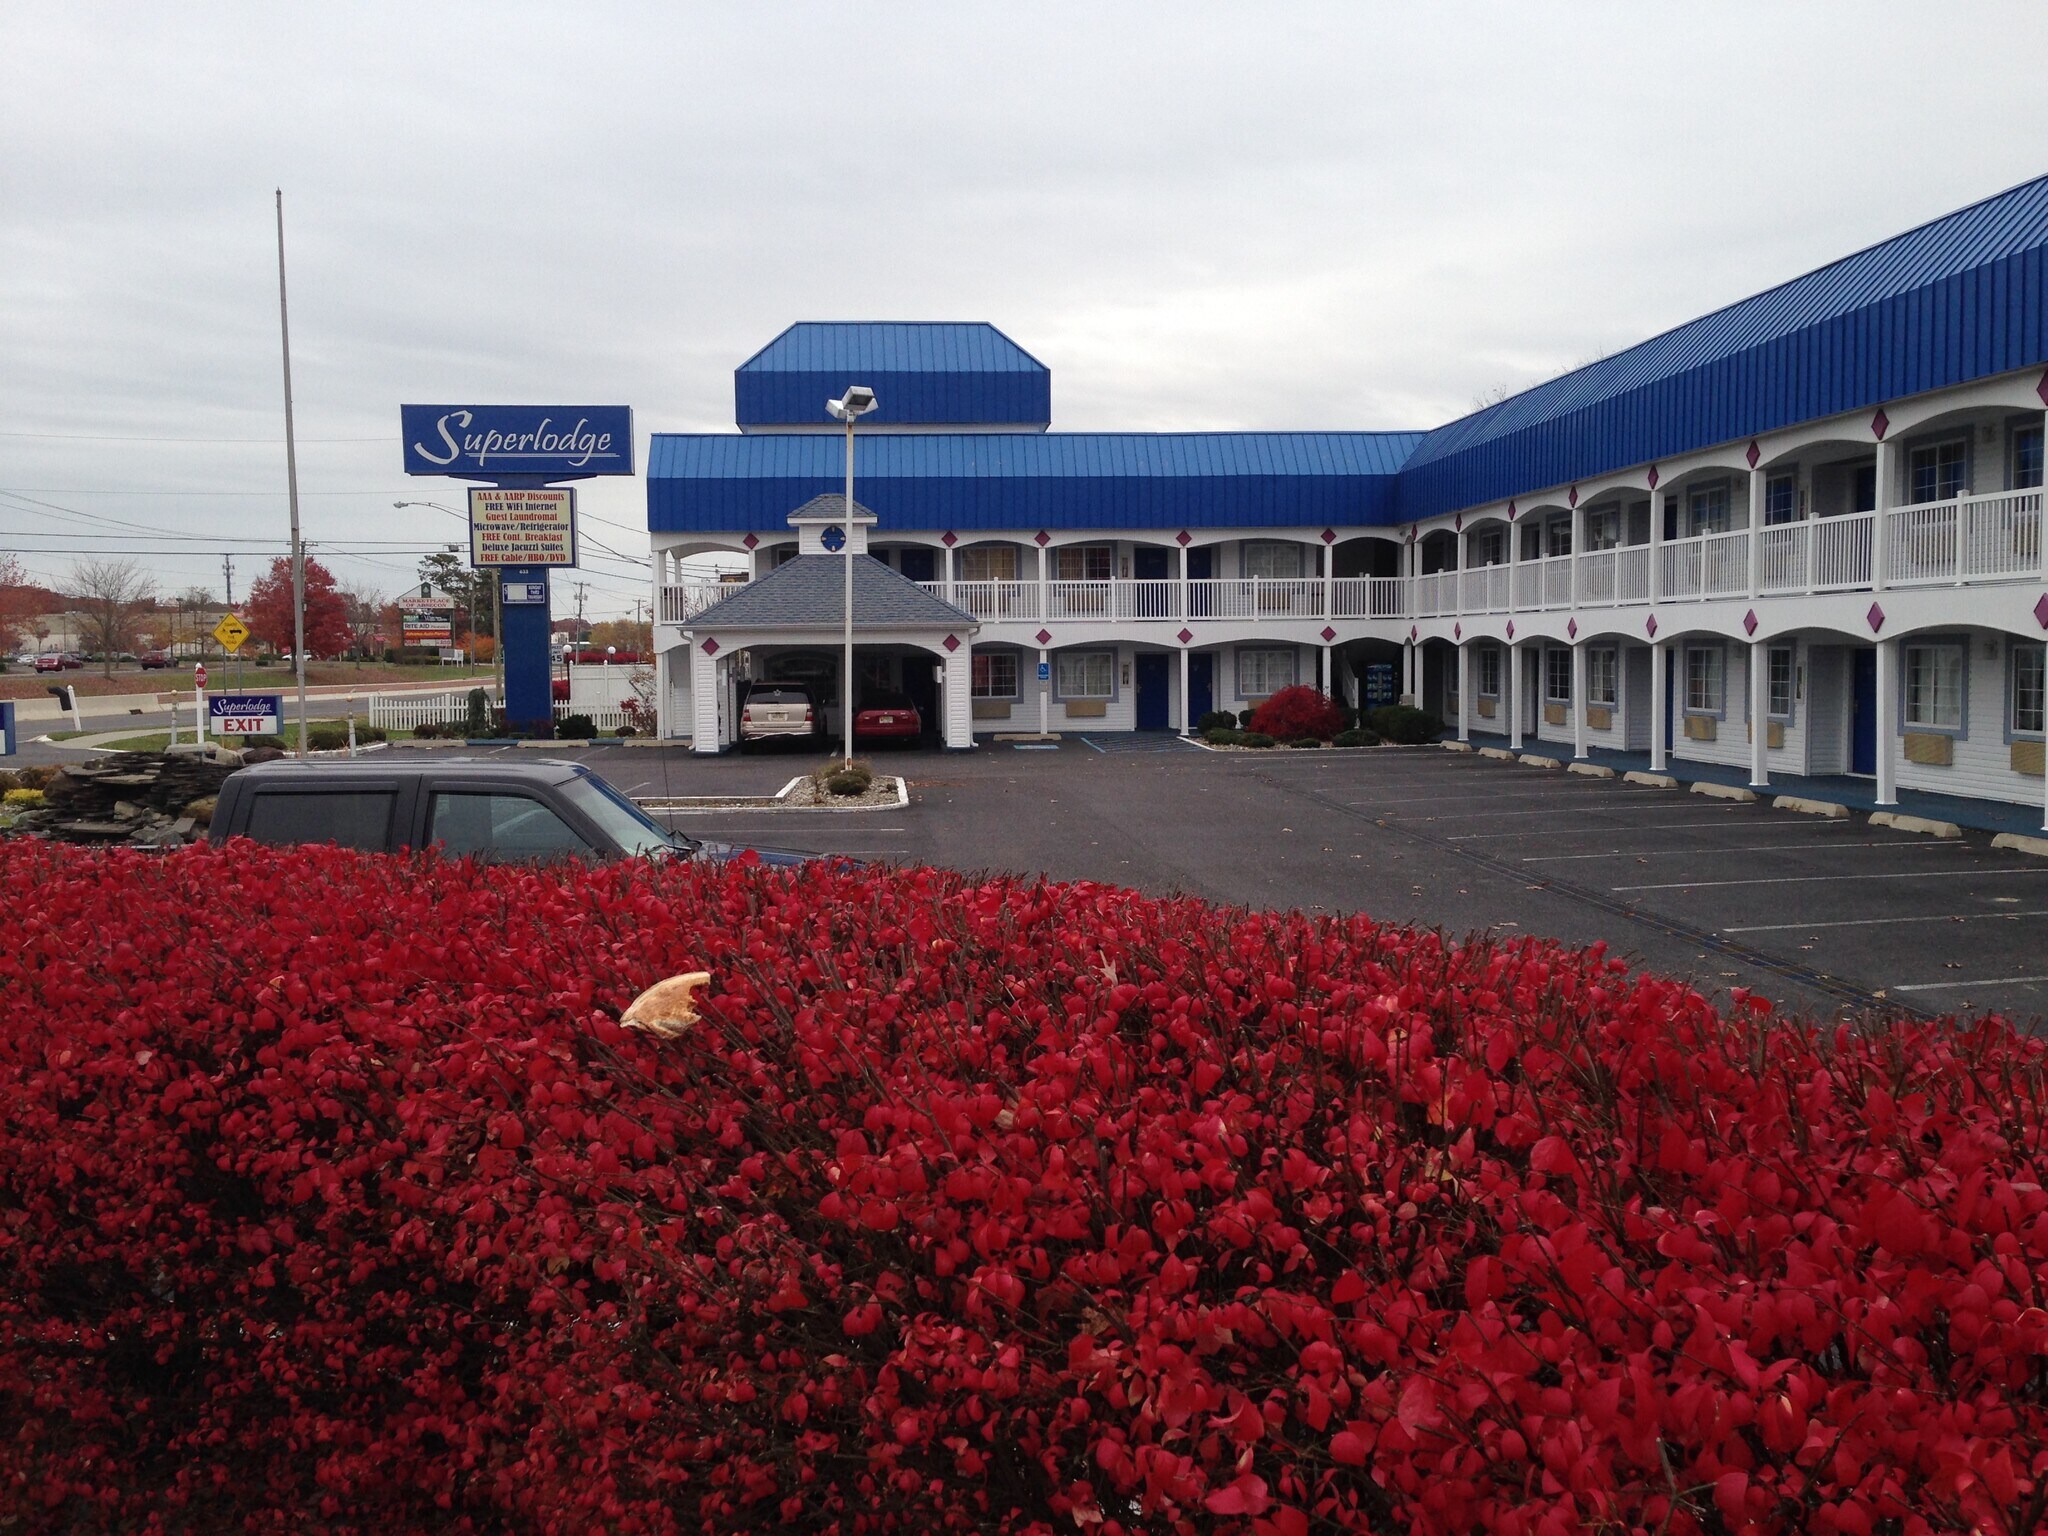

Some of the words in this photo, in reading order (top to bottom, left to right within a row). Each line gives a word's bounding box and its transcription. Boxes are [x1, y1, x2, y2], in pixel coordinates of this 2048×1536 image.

[413, 409, 613, 467] Superlodge
[477, 492, 492, 501] AAA
[495, 492, 501, 501] &
[504, 492, 525, 501] AARP
[527, 492, 565, 501] Discounts
[485, 502, 504, 511] FREE
[525, 502, 557, 511] Internet
[485, 512, 508, 521] Guest
[510, 512, 558, 521] Laundromat
[473, 522, 569, 532] Microwave/Refrigerator
[482, 532, 501, 541] FREE
[525, 532, 563, 541] Breakfast
[482, 543, 509, 552] Deluxe
[511, 543, 539, 552] Jacuzzi
[541, 543, 564, 552] Suites
[480, 553, 499, 562] FREE
[195, 673, 207, 682] STOP
[213, 698, 272, 716] Superlodge
[223, 718, 264, 732] EXIT
